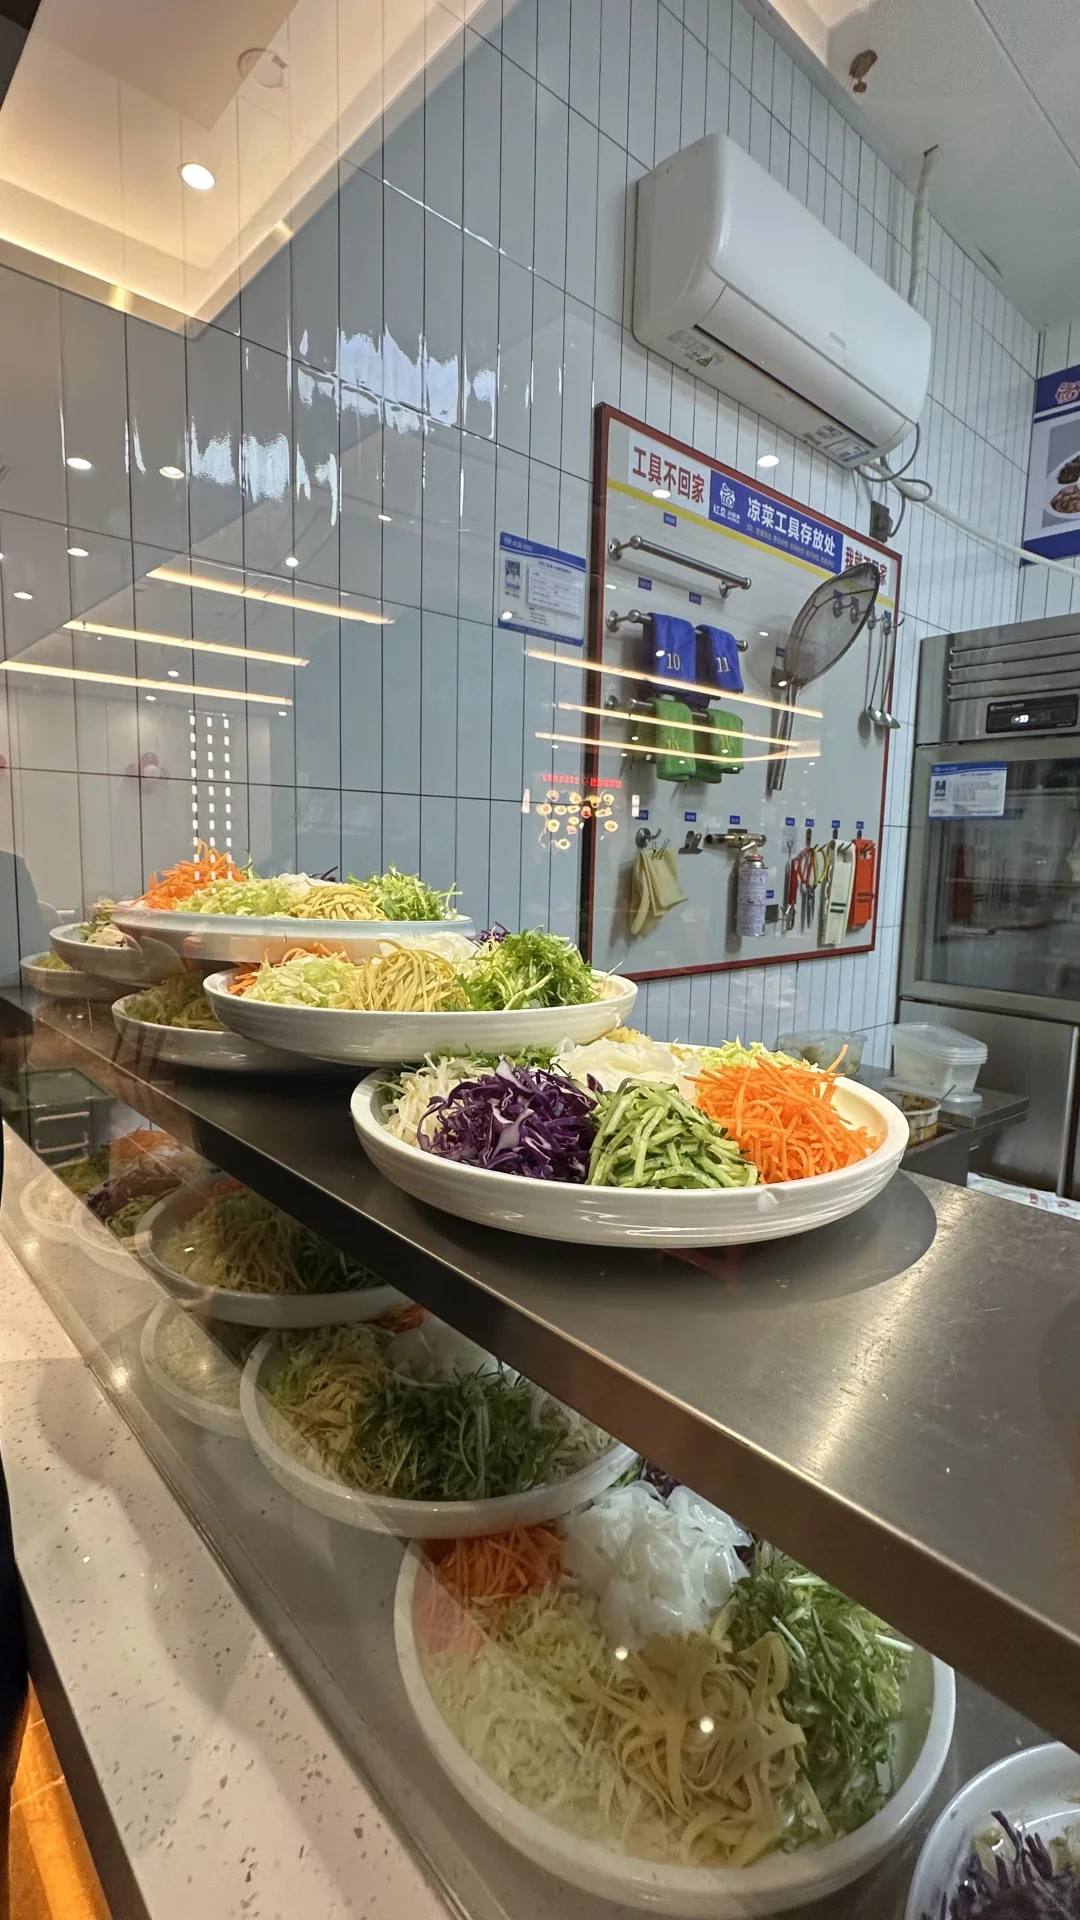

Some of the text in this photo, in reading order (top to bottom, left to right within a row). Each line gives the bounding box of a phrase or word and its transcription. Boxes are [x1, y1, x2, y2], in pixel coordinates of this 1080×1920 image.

[632, 445, 705, 503] 工具不回家
[747, 496, 836, 557] 凉菜工具存放处
[667, 653, 681, 671] 10
[716, 656, 731, 673] 11
